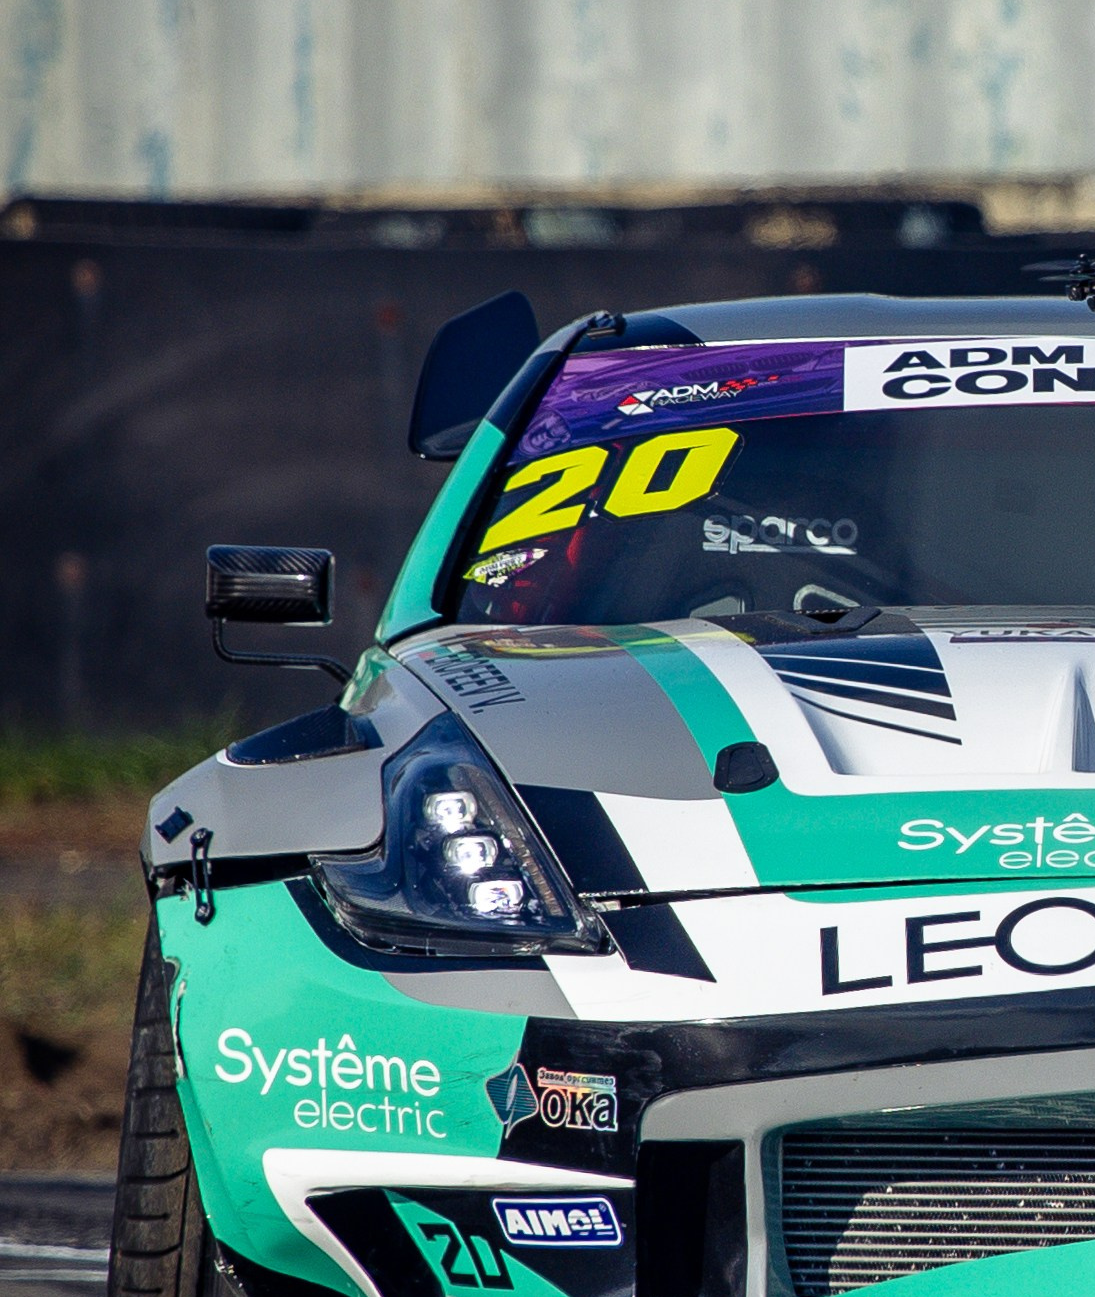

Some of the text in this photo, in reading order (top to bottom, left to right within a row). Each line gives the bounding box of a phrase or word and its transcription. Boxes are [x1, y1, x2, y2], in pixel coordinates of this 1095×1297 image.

[884, 345, 1084, 372] ADM
[651, 389, 742, 407] RACEWAY
[652, 382, 719, 401] ADM
[478, 427, 739, 554] 20
[702, 514, 858, 554] sparco
[214, 1027, 441, 1096] Système
[294, 1089, 447, 1139] electric
[416, 1222, 515, 1290] 20
